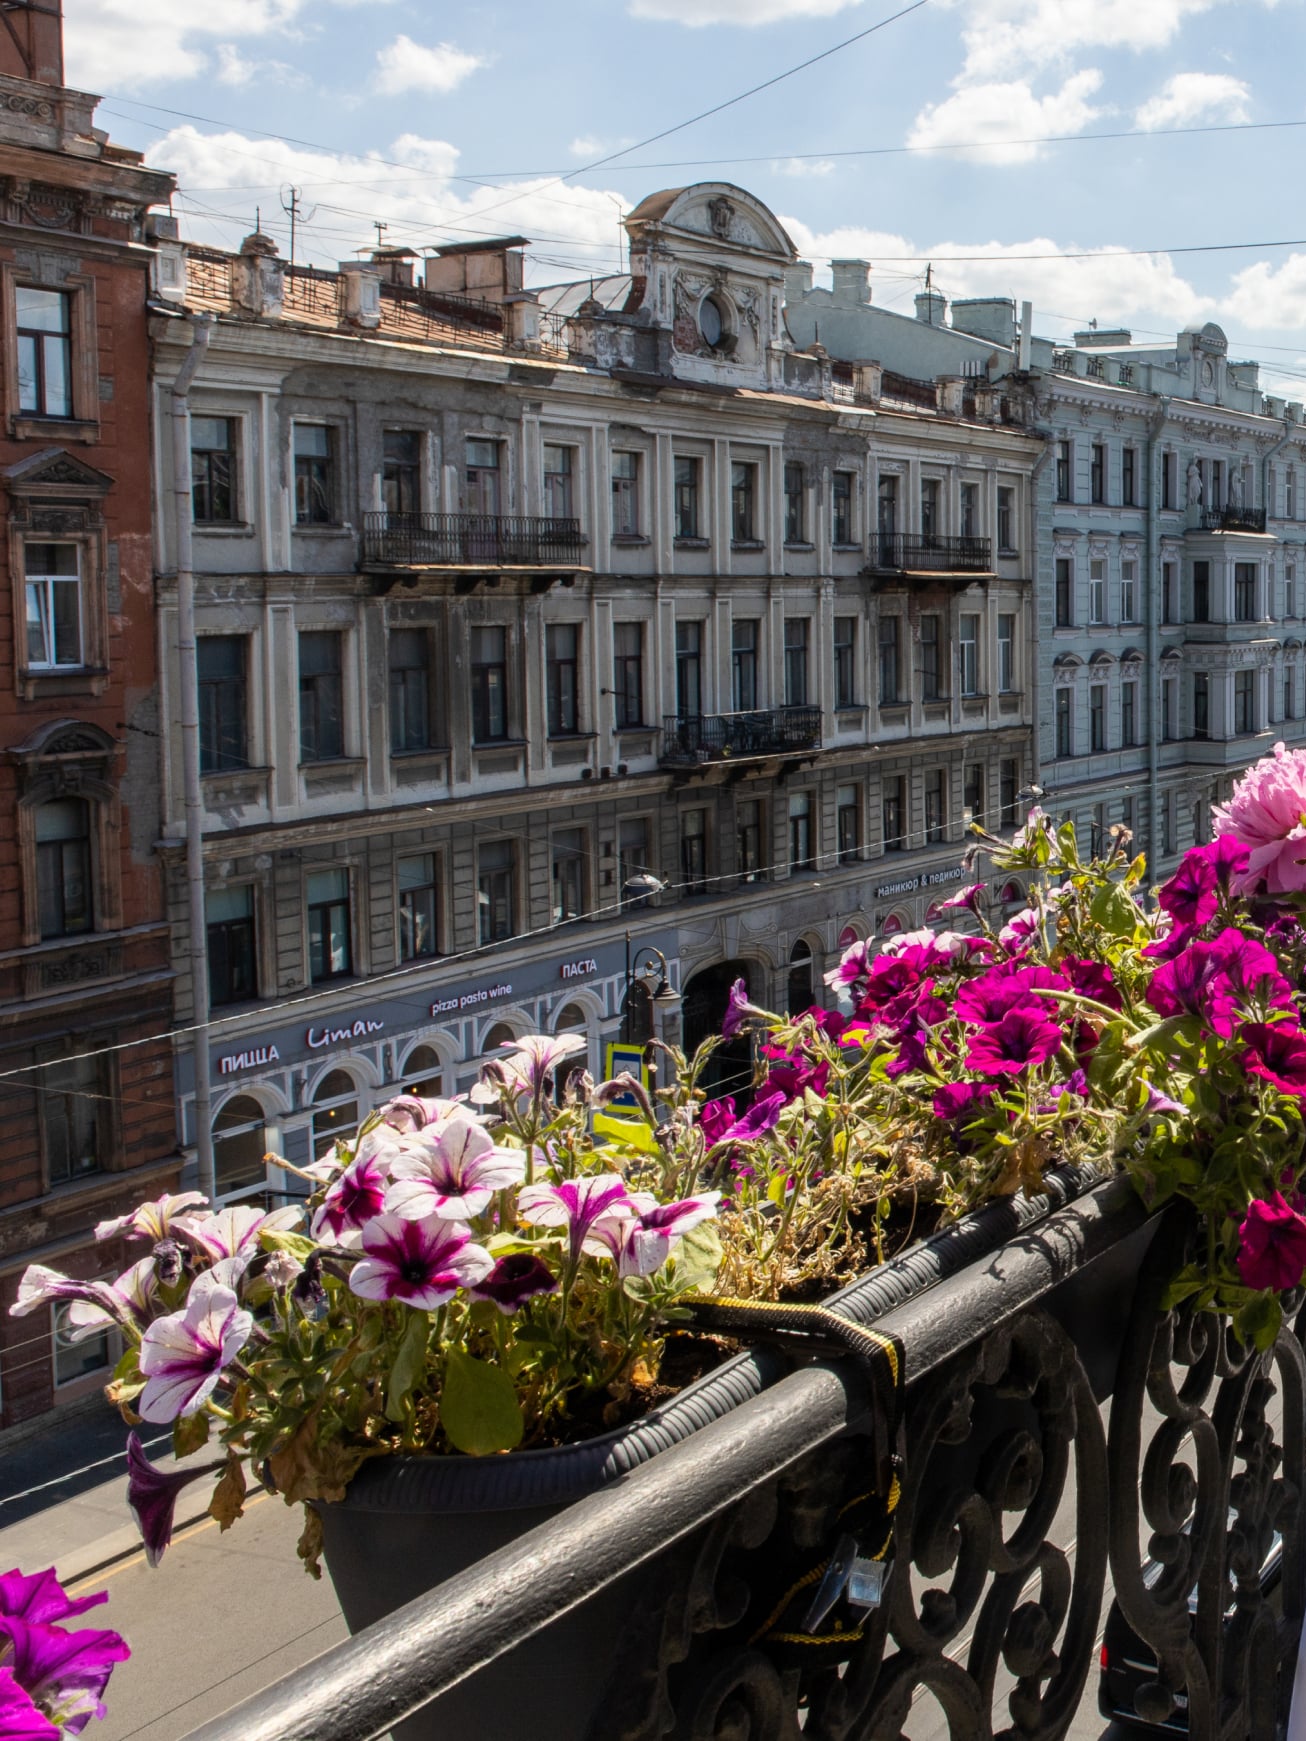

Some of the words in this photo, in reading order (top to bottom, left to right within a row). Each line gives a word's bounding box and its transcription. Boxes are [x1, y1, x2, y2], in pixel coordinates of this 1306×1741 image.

[877, 879, 919, 898] маникюр
[920, 874, 928, 887] &
[929, 867, 966, 885] педикюр
[561, 958, 598, 979] ПАСТА
[432, 998, 459, 1017] pizza
[459, 989, 488, 1009] pasta
[488, 984, 513, 999] wine
[307, 1019, 384, 1048] Liman
[220, 1045, 280, 1074] ПИЦЦА
